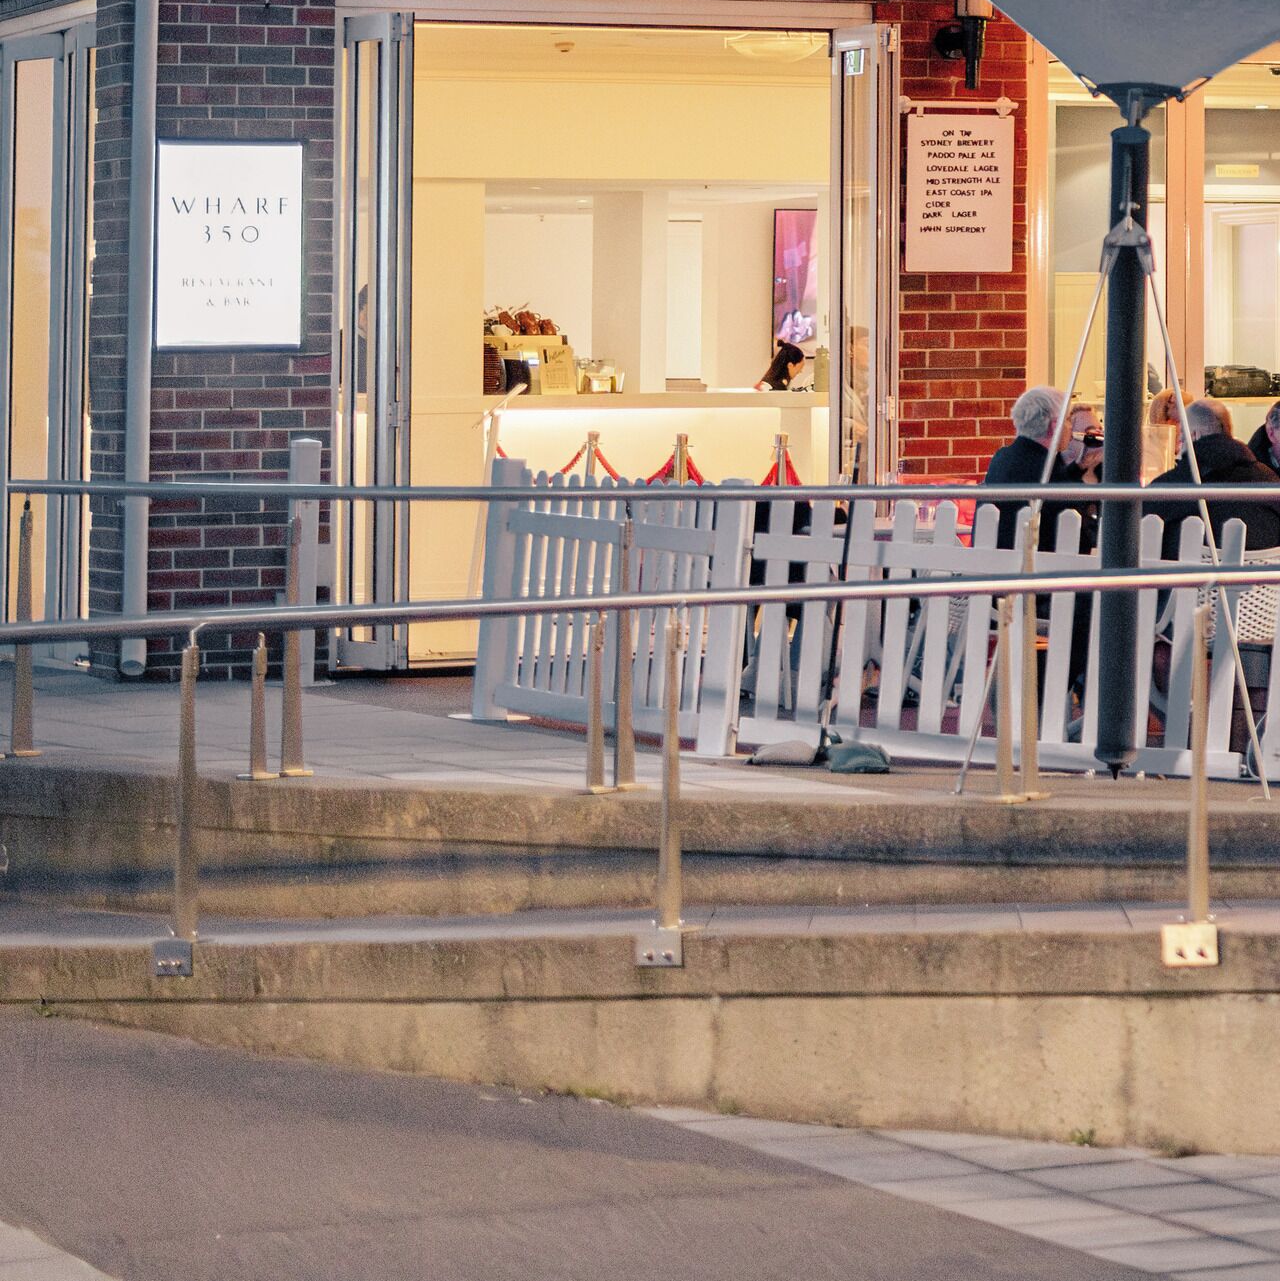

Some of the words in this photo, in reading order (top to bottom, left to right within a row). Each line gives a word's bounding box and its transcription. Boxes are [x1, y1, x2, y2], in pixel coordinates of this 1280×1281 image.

[942, 129, 955, 137] ON
[959, 129, 972, 137] TAP
[920, 139, 953, 147] SYDNEY
[956, 139, 994, 147] BREWERY
[927, 151, 956, 159] PADDO
[980, 151, 996, 159] ALE
[926, 178, 940, 186] MID
[941, 177, 982, 185] STRENGTH
[171, 196, 289, 215] WHARF
[925, 201, 951, 209] CIDER
[922, 211, 943, 219] DARK
[951, 210, 977, 218] LAGER
[204, 225, 259, 244] 350
[224, 297, 249, 307] BAR
